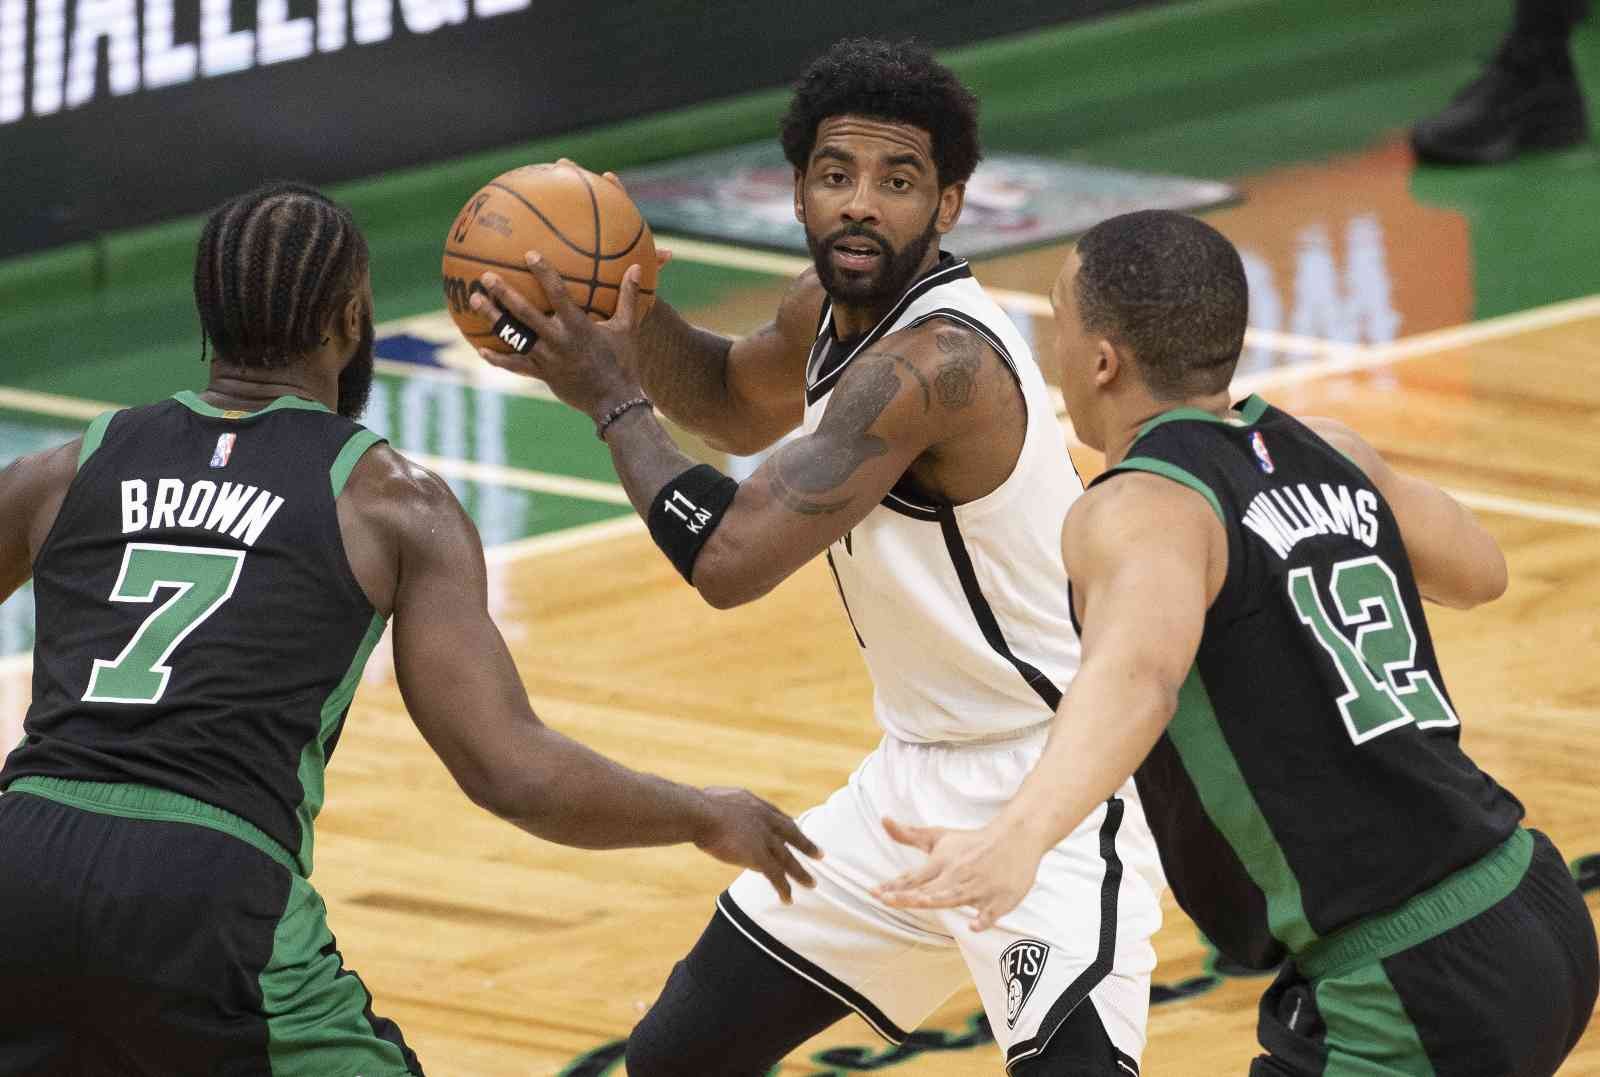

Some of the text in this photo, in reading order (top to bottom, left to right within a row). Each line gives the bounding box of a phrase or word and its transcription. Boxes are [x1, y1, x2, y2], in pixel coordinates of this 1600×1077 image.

[499, 323, 528, 352] KAI
[121, 478, 285, 547] BROWN
[664, 489, 697, 521] 11
[686, 507, 712, 534] KAI
[1241, 483, 1378, 560] WILLIAMS
[81, 542, 246, 704] 7
[1288, 555, 1460, 746] 12
[1001, 945, 1041, 983] NETS
